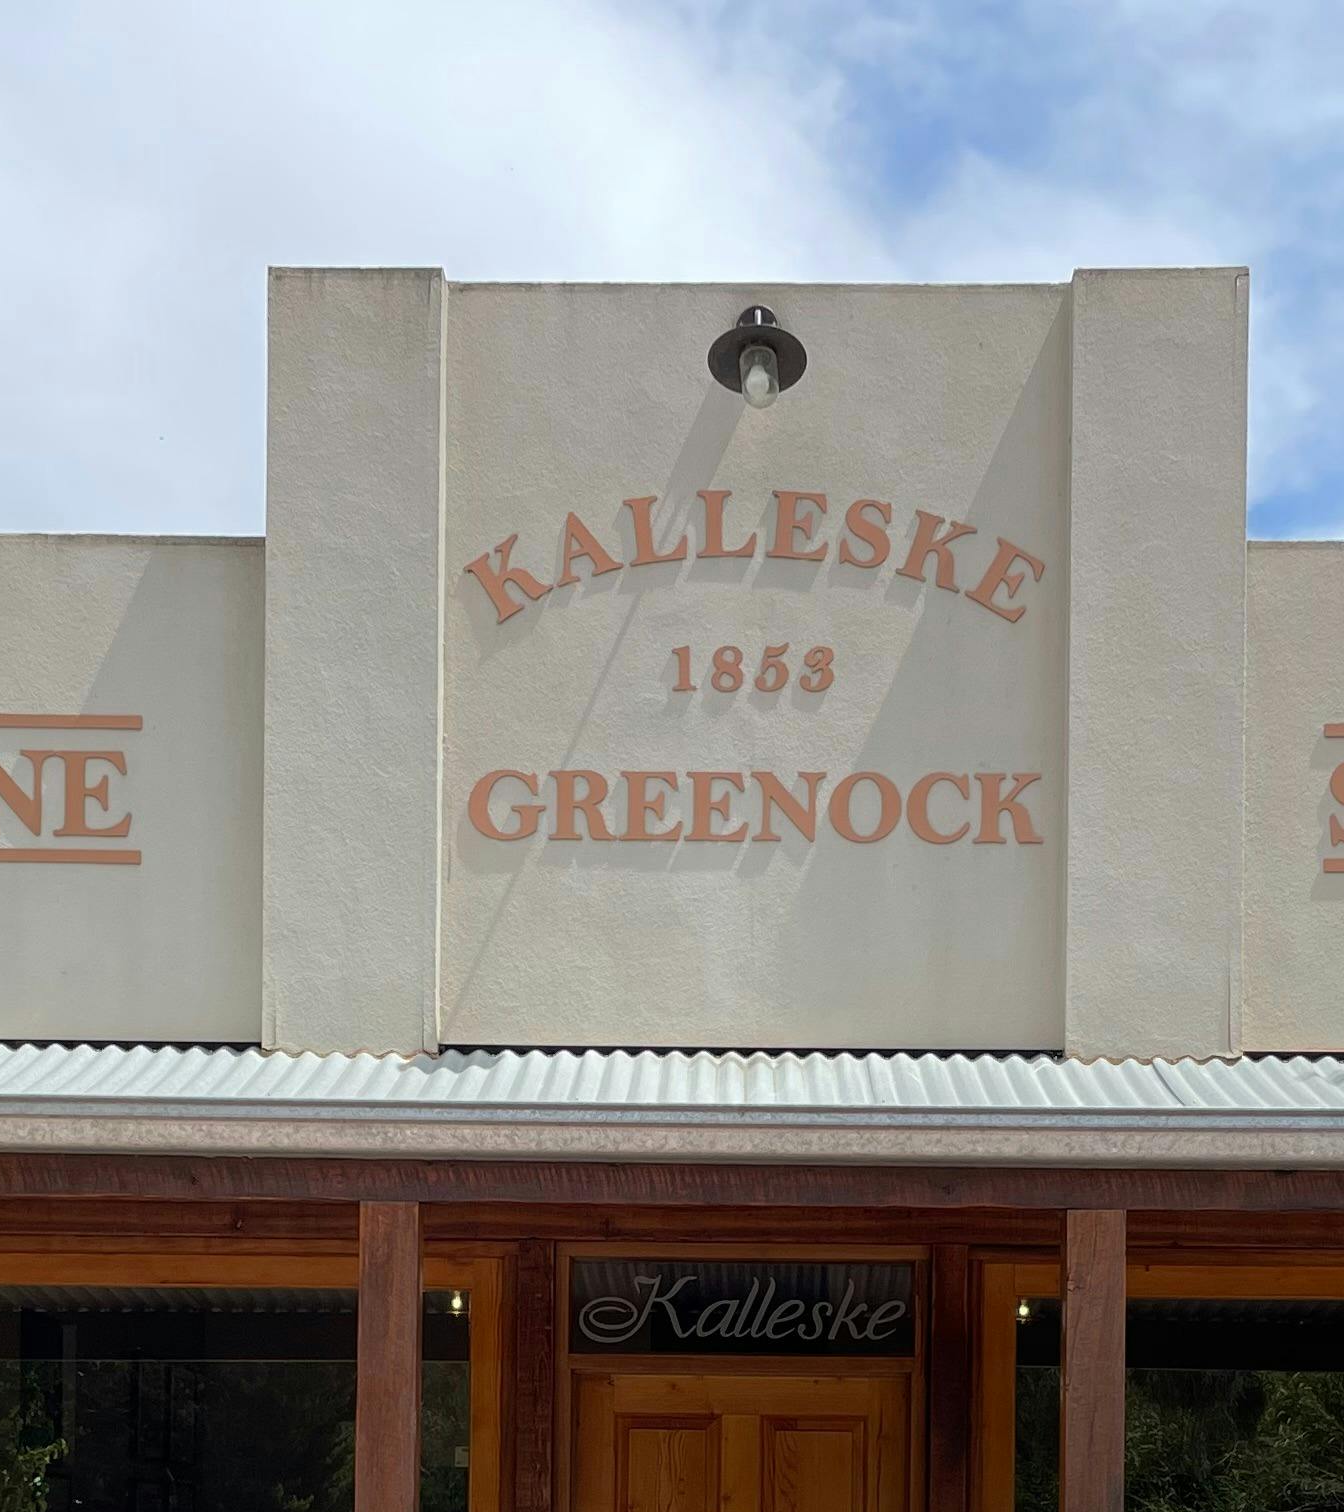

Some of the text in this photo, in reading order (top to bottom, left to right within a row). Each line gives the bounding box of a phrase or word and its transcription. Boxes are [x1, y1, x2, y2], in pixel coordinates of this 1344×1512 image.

[463, 490, 1046, 624] KALLESKE
[671, 643, 835, 693] 1853
[467, 769, 1044, 845] GREENOCK
[579, 1274, 906, 1343] Kalleske
